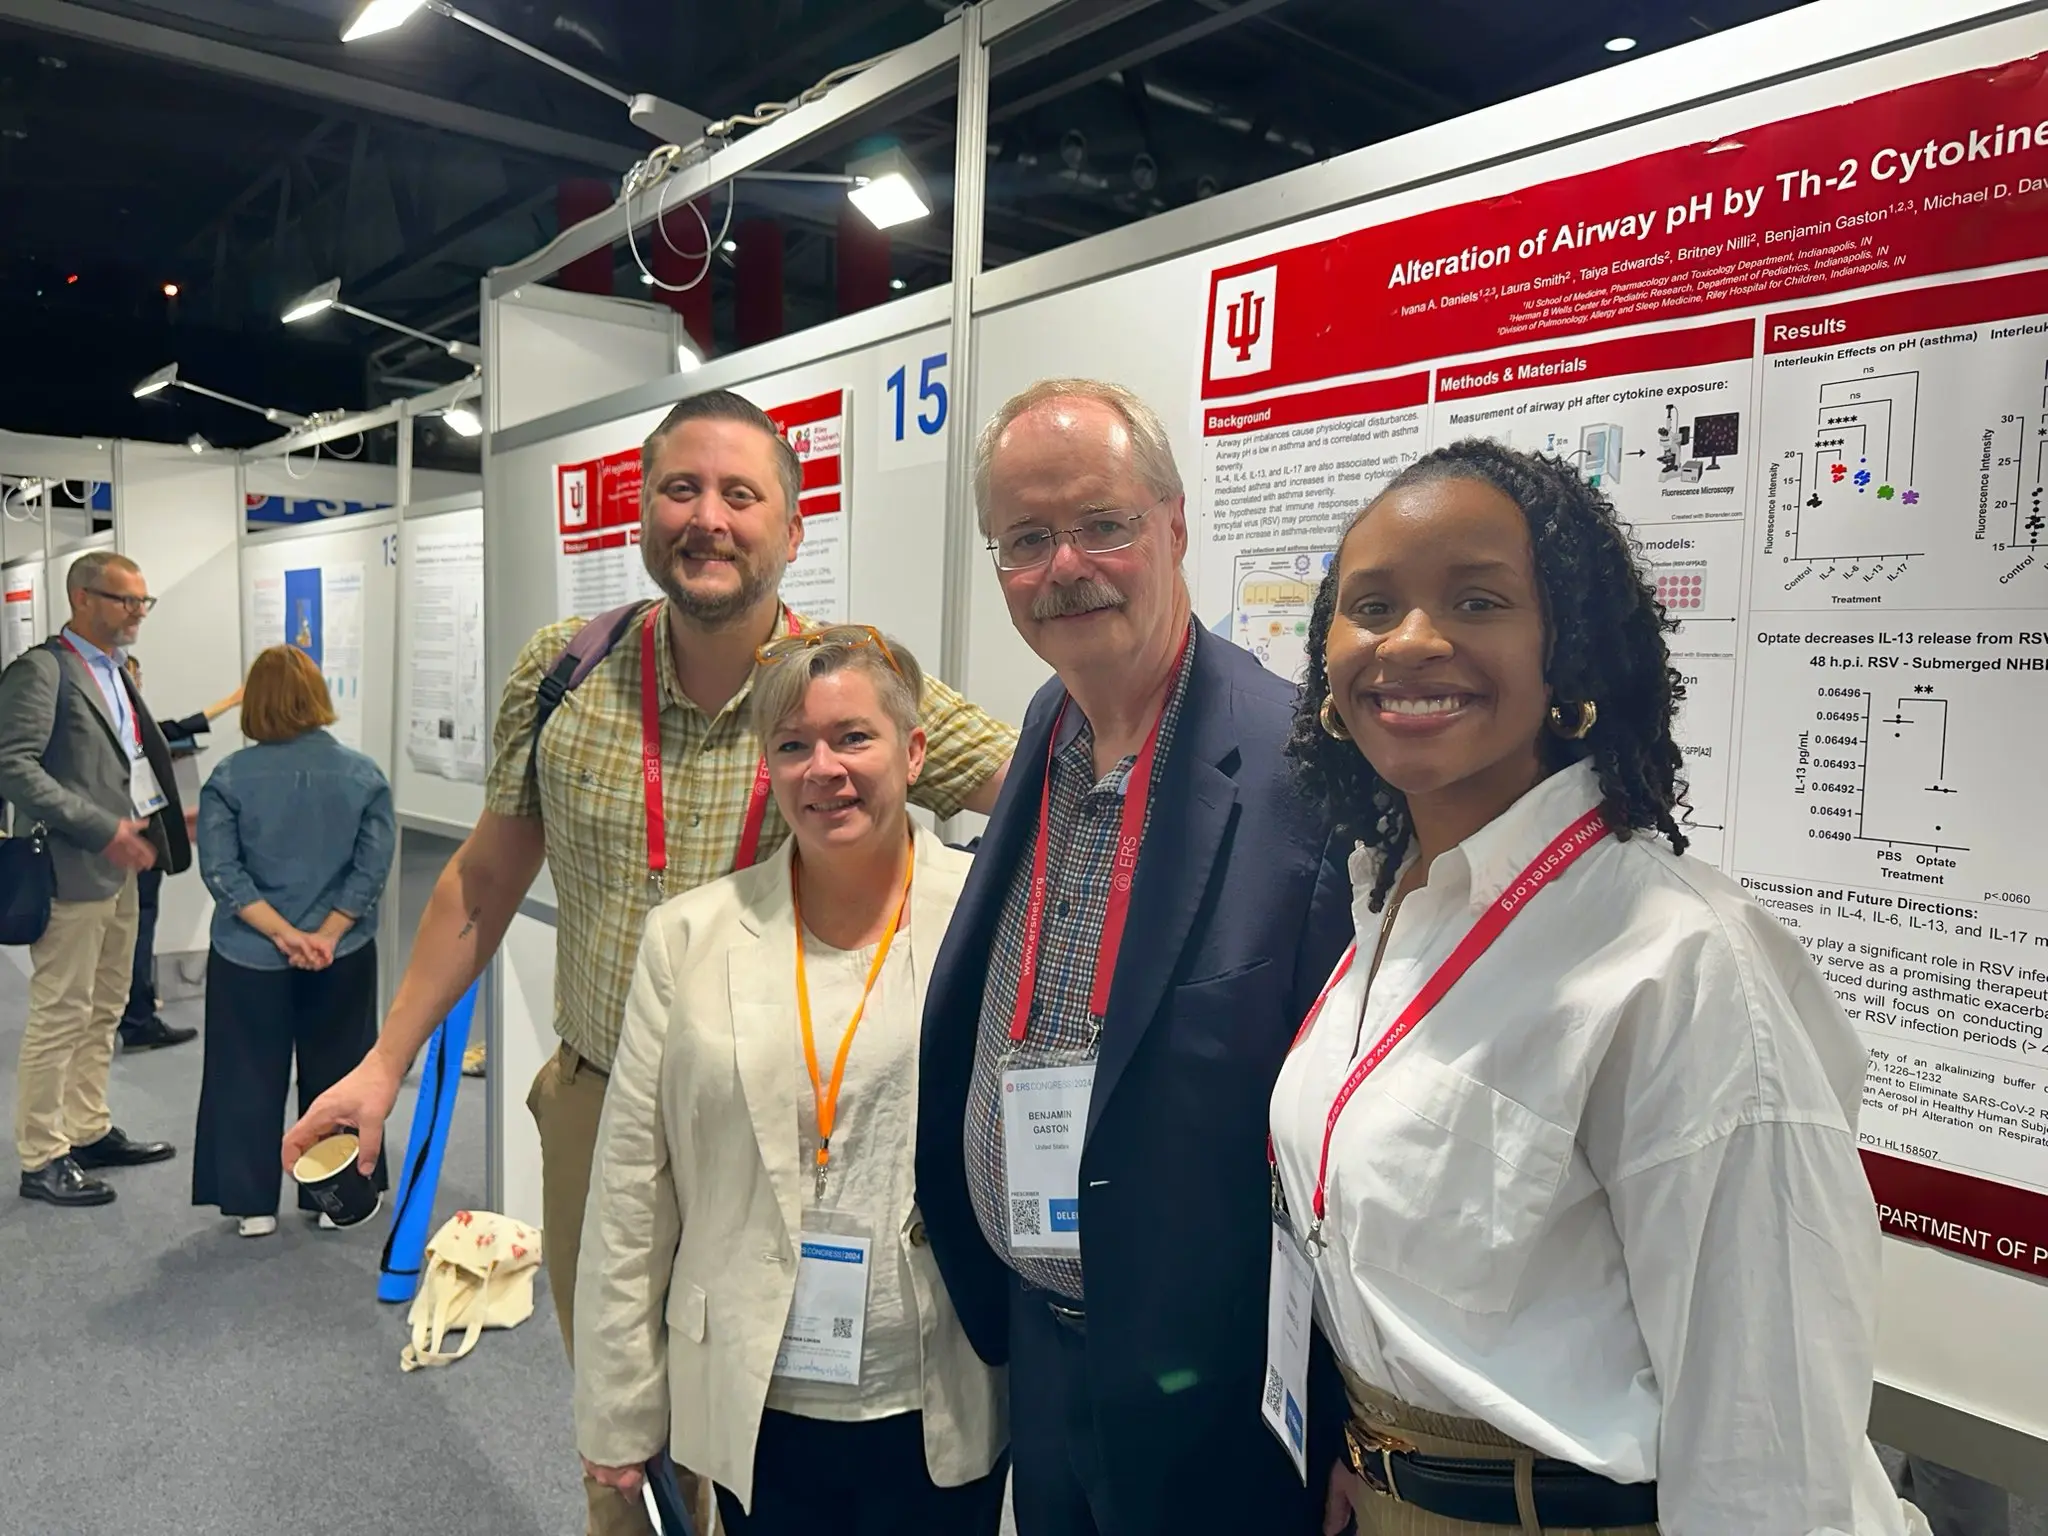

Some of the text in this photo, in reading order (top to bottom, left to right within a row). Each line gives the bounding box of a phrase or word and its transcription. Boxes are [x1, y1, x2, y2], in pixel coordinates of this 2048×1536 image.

[1388, 120, 2048, 288] Alteration of Airway pH by Th-2 Cytokine
[1401, 302, 1426, 316] Ivana
[1501, 282, 1531, 296] Laura
[1580, 266, 1608, 280] Taiya
[1678, 243, 1723, 262] Britney
[1765, 220, 1831, 244] Benjamin
[1924, 187, 1988, 211] Michael
[1994, 184, 2012, 198] D.
[1536, 296, 1562, 308] School
[1564, 294, 1572, 304] of
[1610, 276, 1669, 294] Pharmacology
[1671, 272, 1688, 282] and
[1692, 263, 1735, 280] Toxicology
[1738, 253, 1795, 272] Department,
[1798, 242, 1858, 260] Indianapolis,
[1860, 236, 1873, 246] IN
[1773, 318, 1847, 341] Results
[1774, 331, 1977, 368] Interleukin Effects on pH (asthma)
[1440, 358, 1587, 392] Methods & Materials
[887, 352, 948, 442] 15
[1449, 380, 1728, 425] Measurement of airway pH after cytokine exposure:
[1209, 408, 1271, 429] Background
[2001, 414, 2014, 423] 30
[1217, 438, 1240, 449] Airway
[1243, 436, 1252, 446] pH
[1292, 426, 1314, 437] cause
[1316, 419, 1365, 435] physiological
[1784, 450, 1794, 458] 20
[1998, 457, 2011, 466] 25
[1783, 476, 1794, 484] 15
[1975, 428, 1994, 540] Fluorescence Intensity
[1661, 486, 1734, 496] Fluorescence Microscopy
[1764, 462, 1780, 554] Fluorescence Intensity
[1782, 503, 1792, 511] 10
[1994, 500, 2008, 509] 20
[1646, 538, 1695, 550] models:
[1992, 543, 2005, 551] 15
[1784, 566, 1813, 591] Control
[1819, 566, 1836, 581] IL-4
[1842, 564, 1859, 580] IL-6
[1862, 564, 1884, 584] IL-13
[1886, 563, 1908, 583] IL-17
[1999, 554, 2034, 586] Control
[1831, 595, 1881, 604] Treatment
[1757, 632, 1800, 646] Optate
[1804, 632, 1874, 644] decreases
[1879, 632, 1913, 644] IL-13
[1918, 632, 1971, 644] release
[1976, 632, 2013, 644] from
[1810, 656, 1826, 667] 48
[1830, 657, 1863, 671] h.p.i.
[1868, 657, 1899, 668] RSV
[1912, 657, 2001, 673] Submerged
[1818, 687, 1861, 698] 0.06496
[1816, 711, 1859, 722] 0.06495
[1815, 735, 1858, 746] 0.06494
[646, 758, 660, 784] ERS
[1795, 730, 1810, 794] IL-13 pg/mL
[1813, 759, 1856, 770] 0.06493
[1812, 782, 1855, 794] 0.06492
[1810, 806, 1853, 817] 0.06491
[1809, 829, 1851, 841] 0.06490
[1119, 835, 1137, 869] ERS
[1877, 850, 1957, 868] PBS Optate
[1881, 868, 1944, 885] Treatment
[1740, 877, 1978, 919] Discussion and Future Directions:
[1984, 891, 2031, 905] p<.0060
[1022, 876, 1045, 976] www.ersnet.org
[1820, 903, 1831, 915] in
[1837, 906, 1866, 922] IL-4,
[1873, 911, 1902, 927] IL-6,
[1909, 916, 1948, 934] IL-13,
[1955, 922, 1982, 937] and
[1989, 927, 2027, 944] IL-17
[1817, 937, 2048, 983] play a significant role in RSV infe
[1828, 956, 2048, 1003] serve as a promising therapeut
[1327, 1023, 1406, 1132] www.ersnet.org
[1909, 1081, 2035, 1117] Eliminate SARS-CoV-2
[1029, 1110, 1072, 1121] BENJAMIN
[1033, 1124, 1069, 1134] GASTON
[1876, 1202, 2028, 1259] PARTMENT OF
